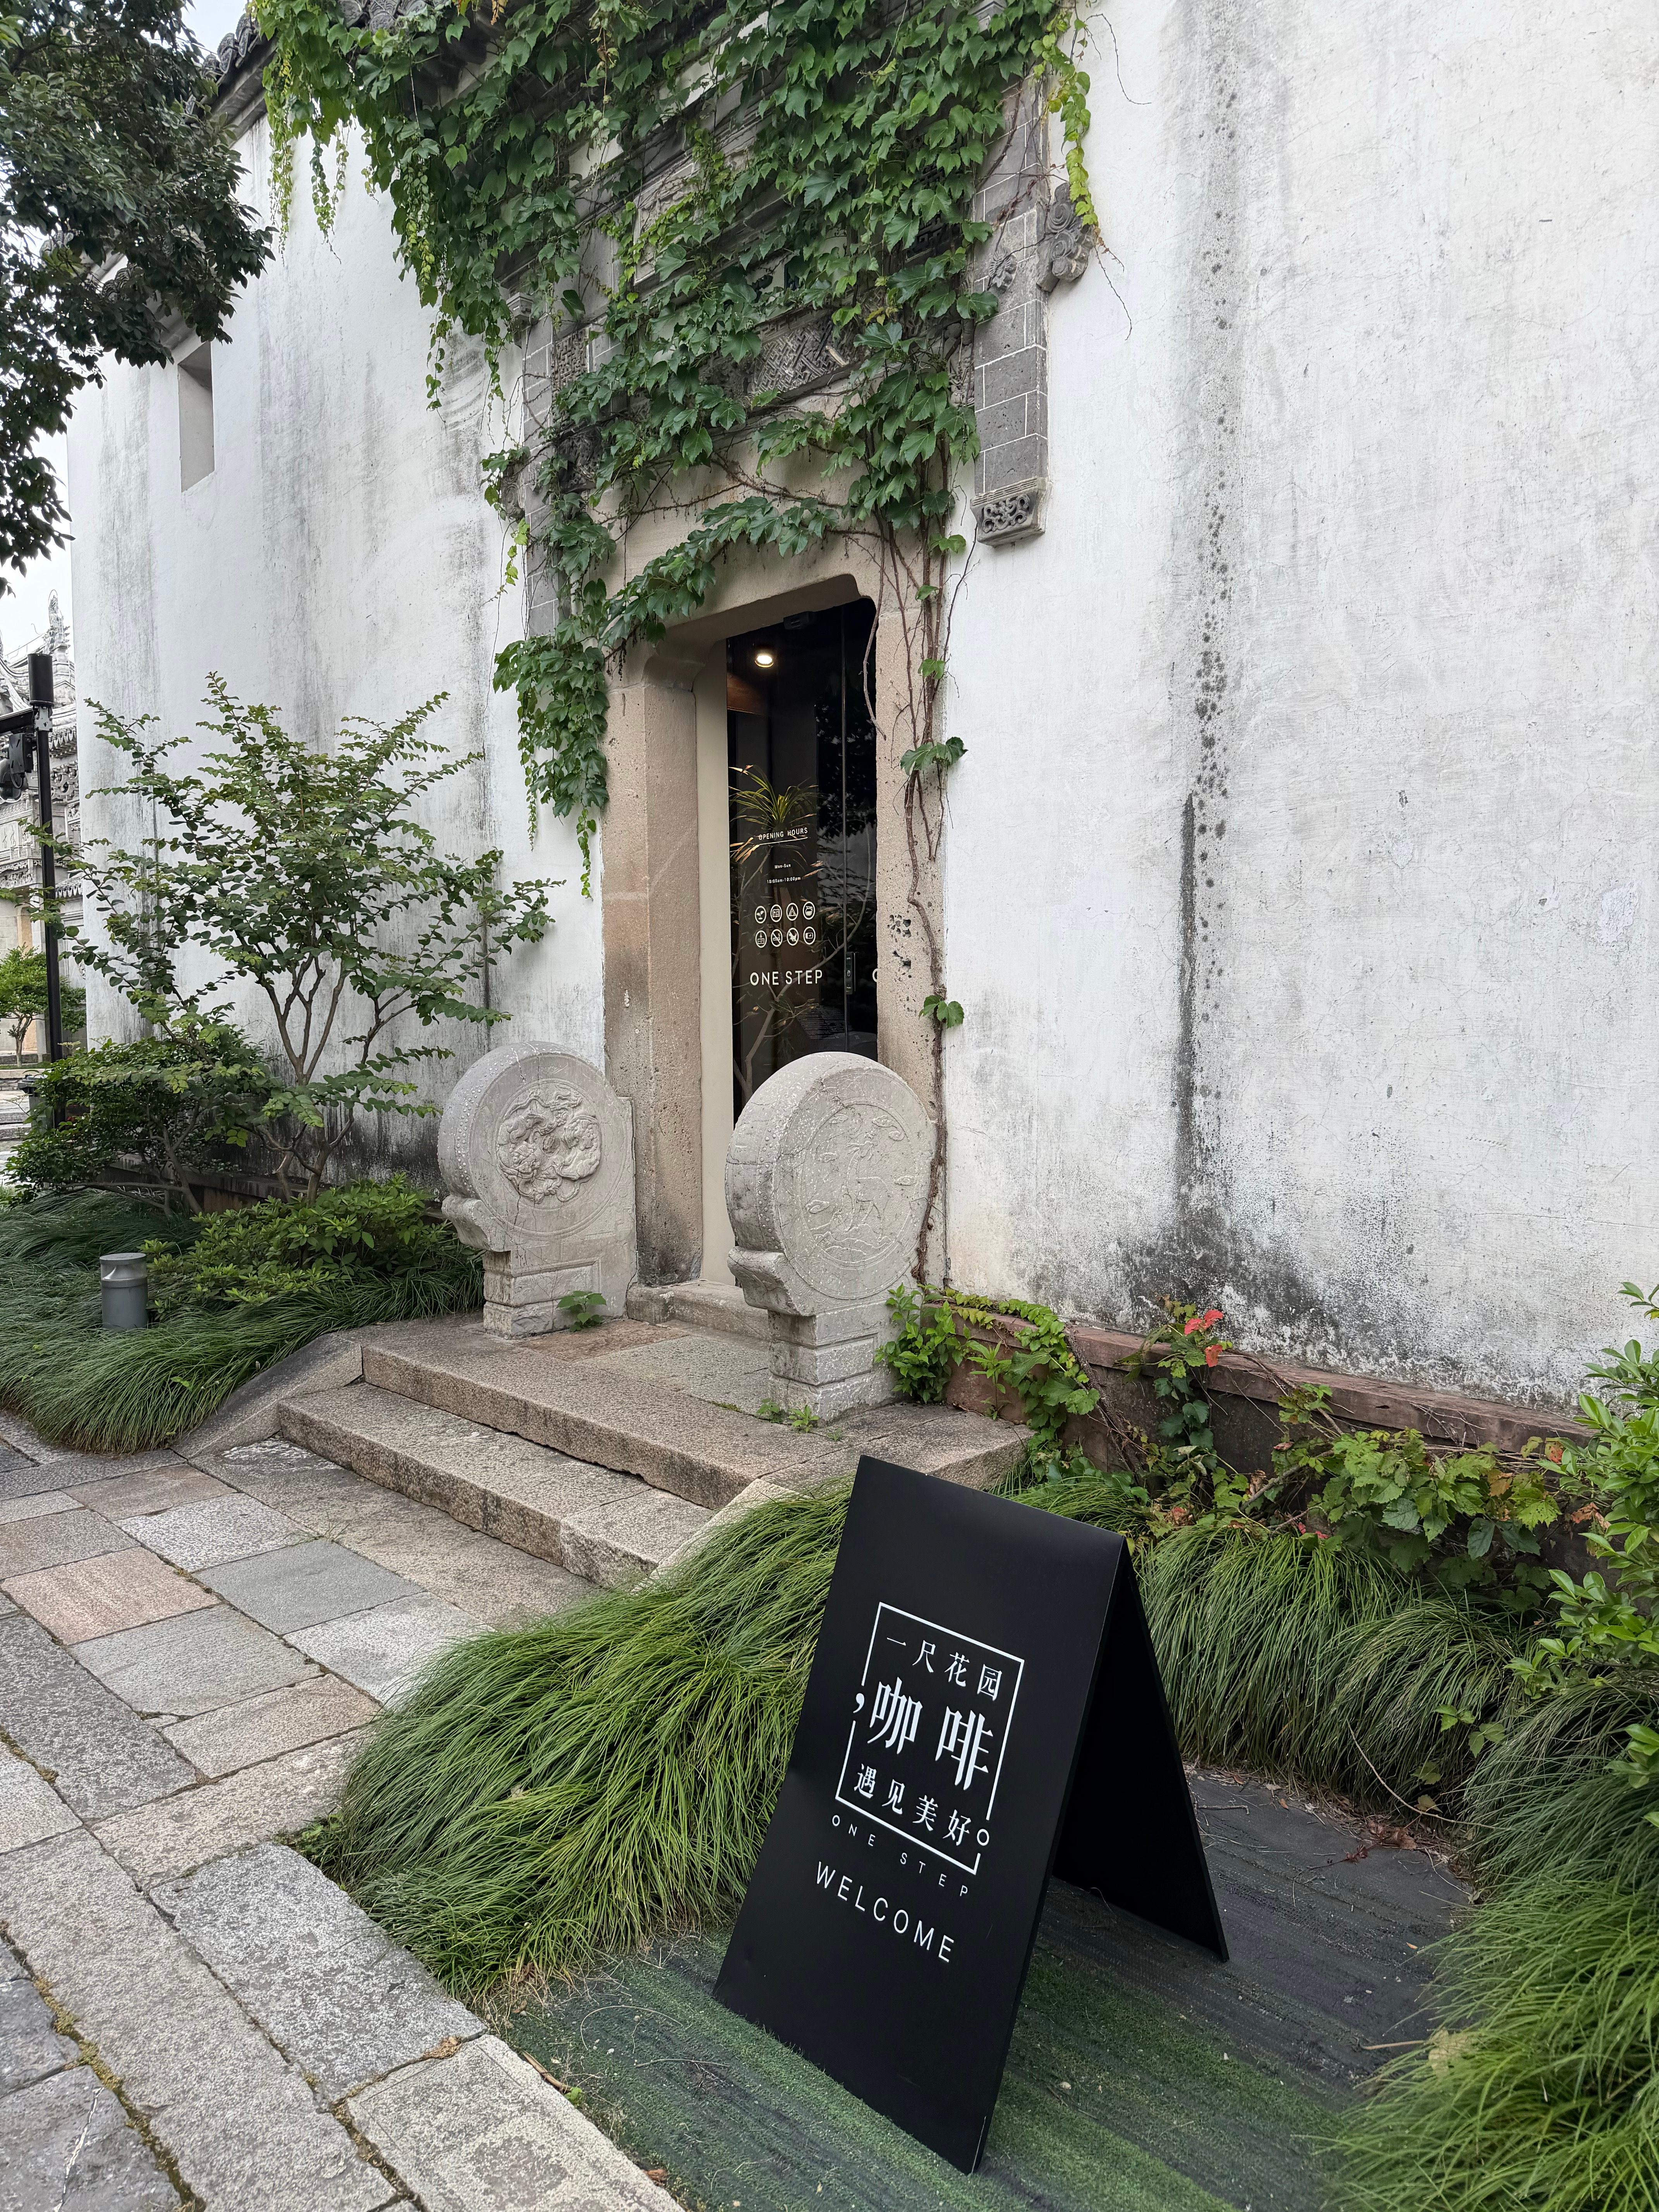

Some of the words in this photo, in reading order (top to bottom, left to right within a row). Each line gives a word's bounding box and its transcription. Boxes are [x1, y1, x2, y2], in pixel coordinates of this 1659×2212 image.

[759, 831, 784, 840] OPENING
[787, 827, 808, 836] HOURS
[750, 971, 779, 986] ONE
[786, 970, 822, 984] STEP
[887, 1638, 1002, 1701] 一尺花园
[832, 1815, 876, 1846] ONE
[900, 1853, 968, 1896] STEP
[816, 1861, 955, 1963] WELCOME
